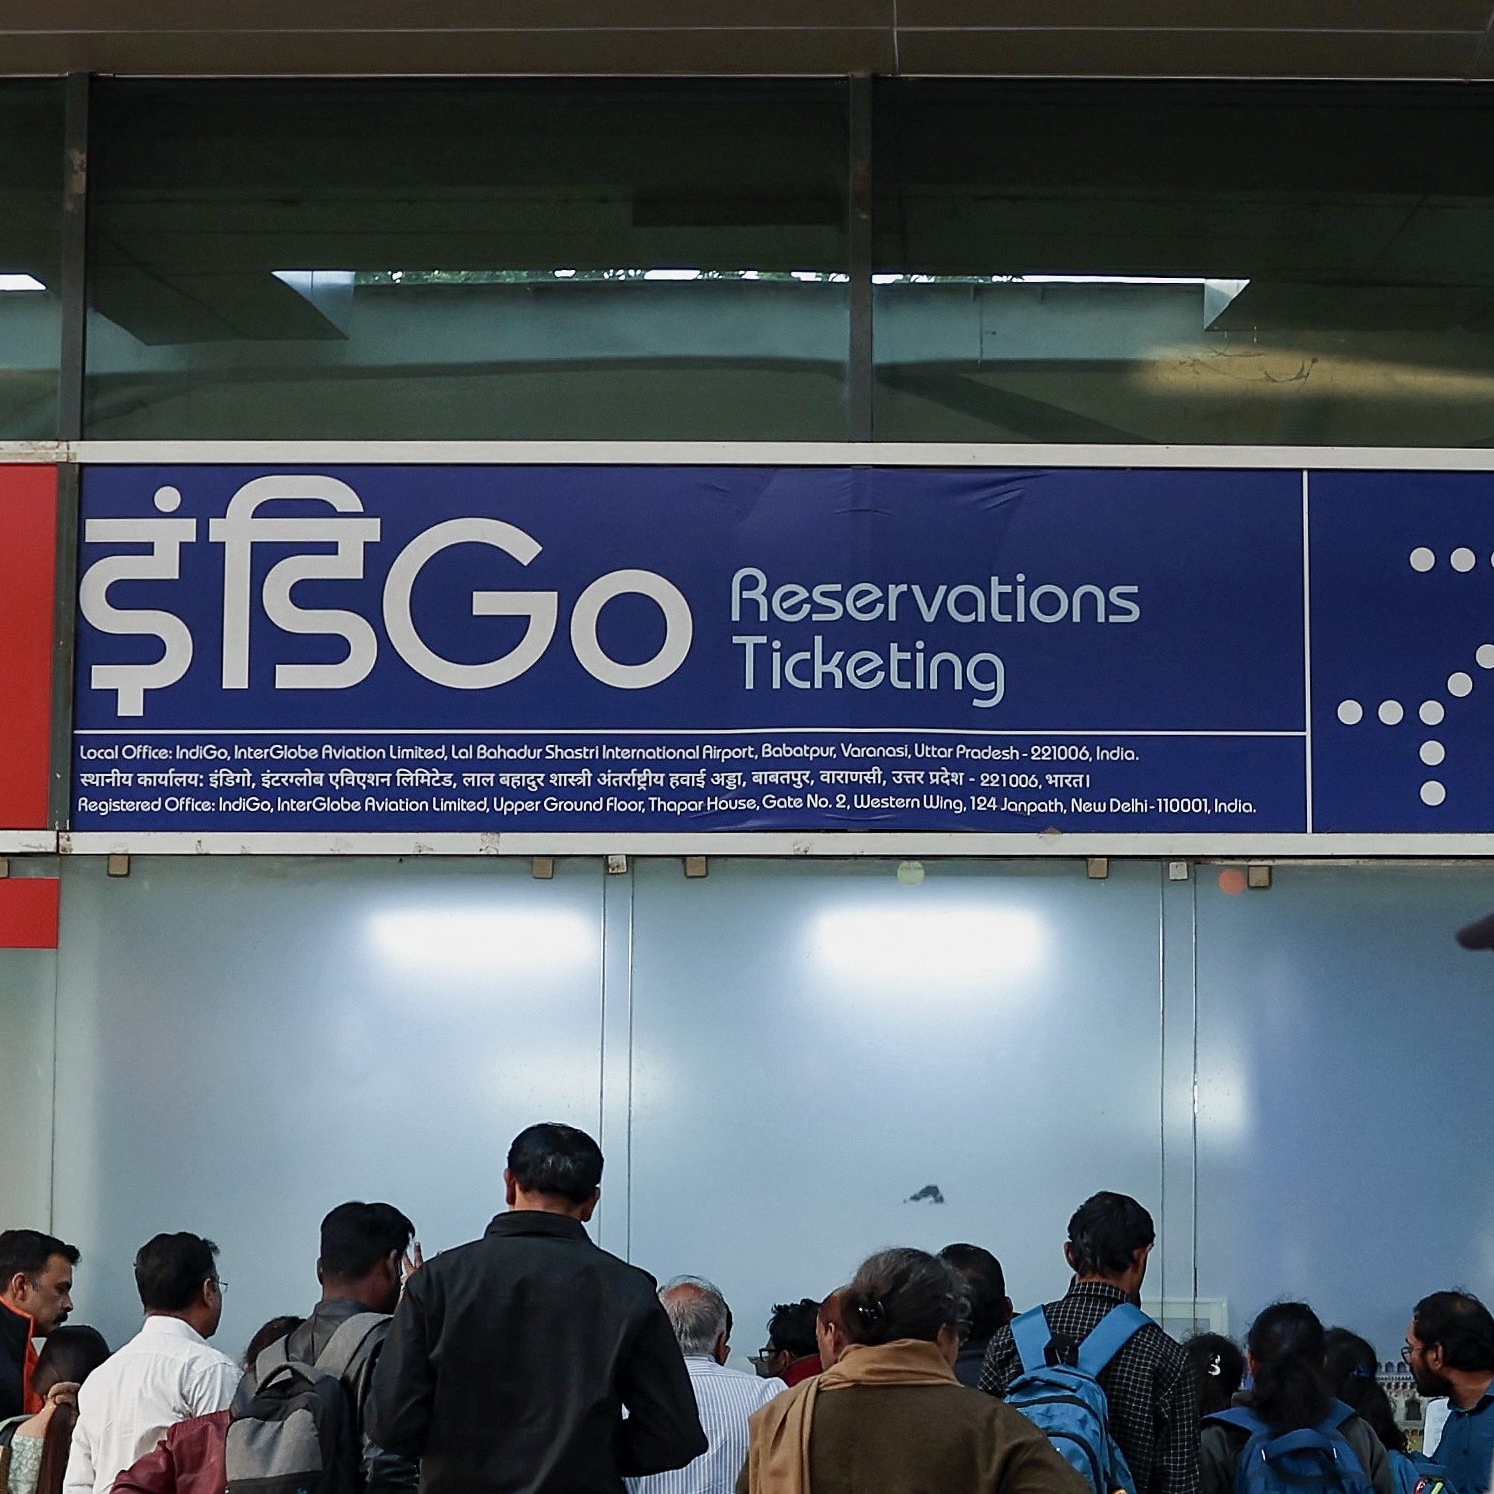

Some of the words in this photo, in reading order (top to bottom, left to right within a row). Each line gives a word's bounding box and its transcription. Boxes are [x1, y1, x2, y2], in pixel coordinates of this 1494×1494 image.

[731, 567, 1140, 623] Reservations
[732, 635, 1005, 708] Ticketing
[80, 744, 119, 760] Local
[121, 744, 173, 760] Office:
[175, 744, 231, 761] IndiGo,
[234, 744, 319, 760] InterGlobe
[321, 744, 386, 760] Aviation
[389, 744, 448, 761] Limited,
[451, 744, 473, 760] Lal
[476, 744, 543, 760] Bahadur
[544, 744, 599, 760] Shastri
[602, 744, 700, 760] International
[702, 744, 759, 763] Airport,
[761, 742, 837, 761] Babatpur,
[840, 742, 912, 759] Varanasi,
[914, 743, 954, 759] Uttar
[956, 744, 1020, 761] Pradesh
[1030, 745, 1093, 762] 221006,
[1096, 745, 1139, 761] India.
[79, 768, 134, 787] स्थानीय
[136, 767, 204, 787] कार्यालय:
[208, 767, 256, 789] इंडिगो,
[260, 767, 325, 789] इंटरग्लोब
[327, 767, 393, 790] एविएशन
[395, 767, 457, 789] लिमिटेड,
[461, 773, 496, 787] लाल
[498, 773, 546, 792] बहादुर
[549, 768, 593, 787] शास्त्री
[596, 768, 666, 791] अंतर्राष्ट्रीय
[668, 768, 707, 790] हवाई
[710, 772, 747, 791] अड्डा,
[751, 770, 815, 789] बाबतपुर,
[819, 767, 887, 787] वाराणसी,
[891, 770, 925, 785] उत्तर
[928, 766, 965, 787] प्रदेश
[980, 772, 1043, 790] 221006,
[1045, 773, 1090, 788] भारत।
[78, 796, 162, 816] Registered
[164, 796, 216, 812] Office:
[218, 796, 274, 814] IndiGo,
[277, 796, 362, 812] InterGlobe
[364, 796, 429, 812] Aviation
[432, 796, 490, 814] Limited,
[493, 796, 541, 816] Upper
[543, 796, 604, 812] Ground
[606, 796, 646, 814] Floor,
[647, 796, 704, 816] Thapar
[706, 796, 760, 811] House,
[761, 793, 804, 809] Gate
[806, 793, 833, 809] No.
[835, 793, 851, 810] 2,
[853, 794, 921, 809] Western
[923, 794, 967, 814] Wing,
[969, 795, 998, 811] 124
[1000, 797, 1067, 816] Janpath,
[1071, 797, 1107, 813] New
[1214, 798, 1257, 813] India.
